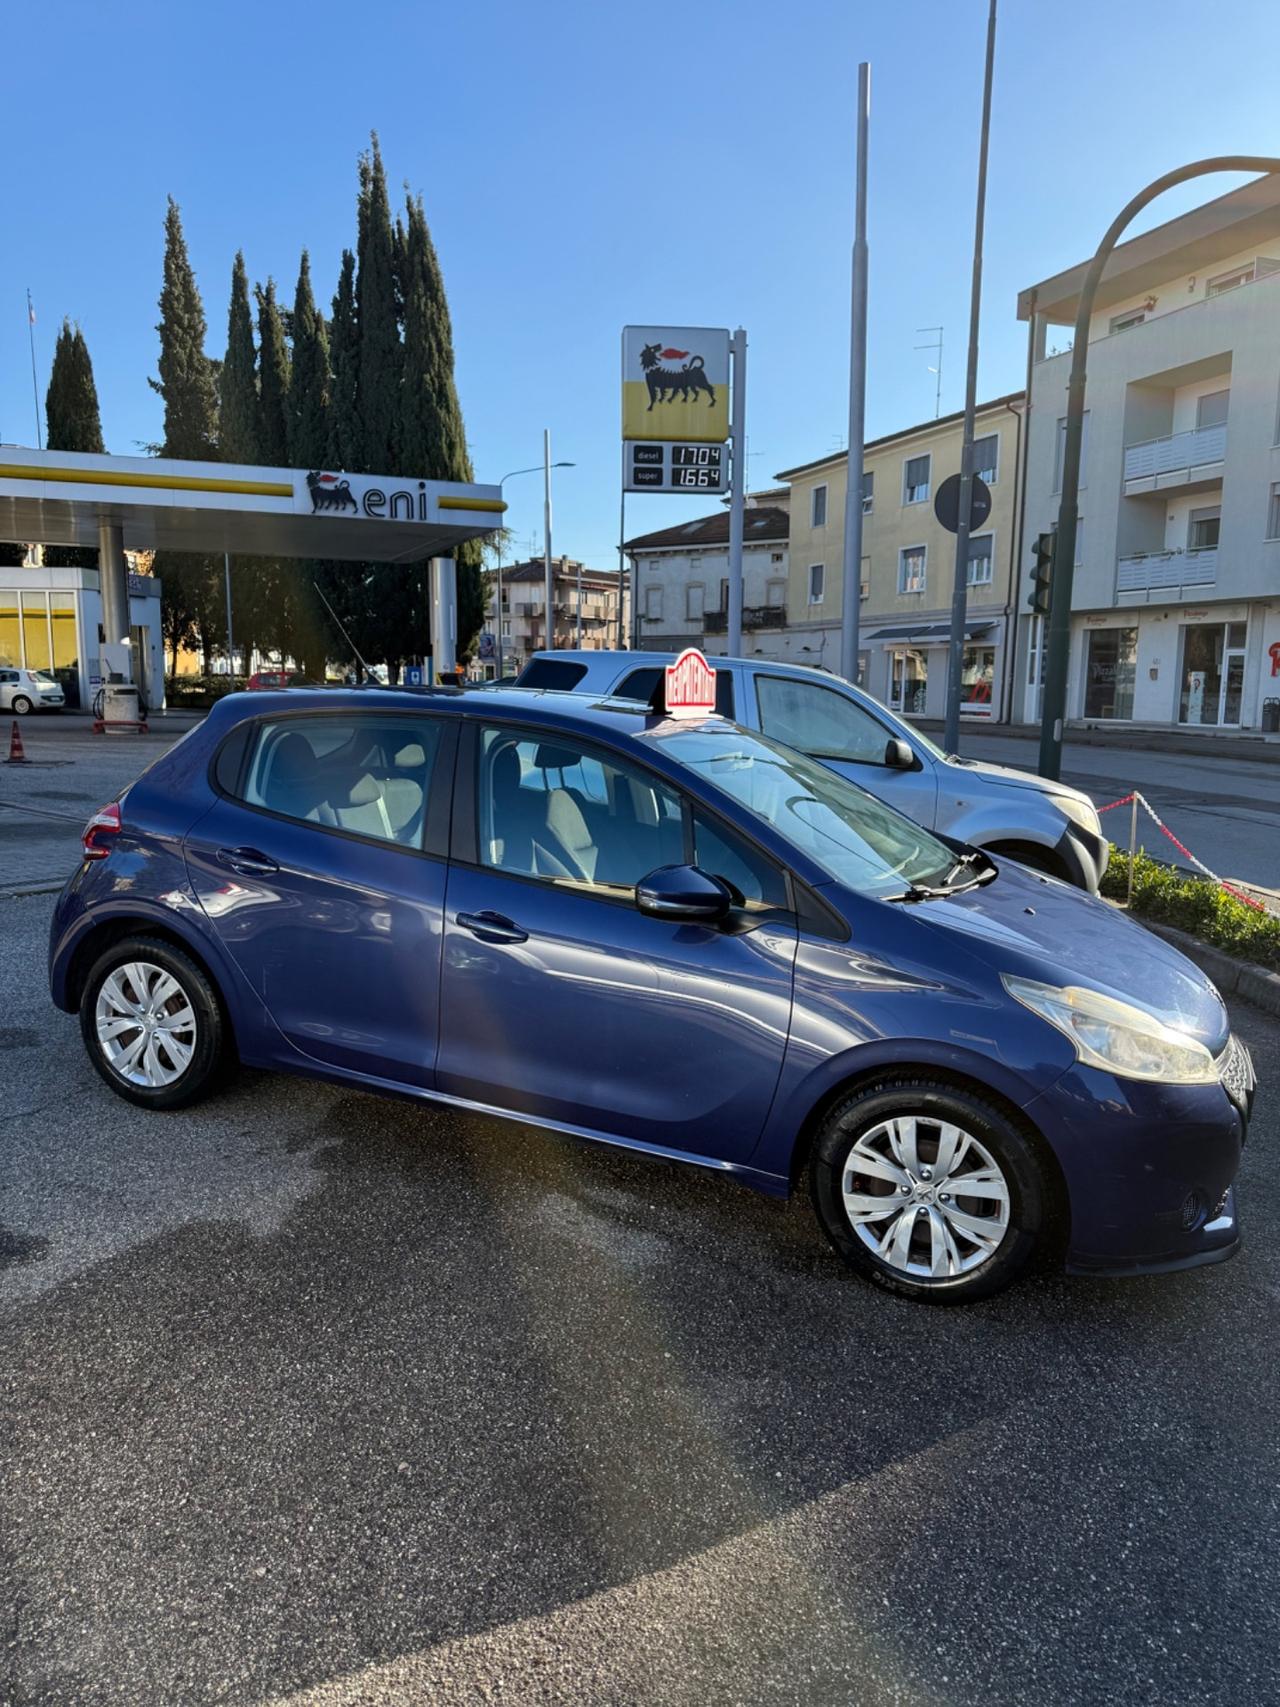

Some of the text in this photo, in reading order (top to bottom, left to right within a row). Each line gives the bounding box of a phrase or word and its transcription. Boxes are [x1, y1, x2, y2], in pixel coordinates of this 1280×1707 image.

[638, 450, 658, 460] diesel
[638, 472, 657, 481] super
[363, 481, 427, 521] eni
